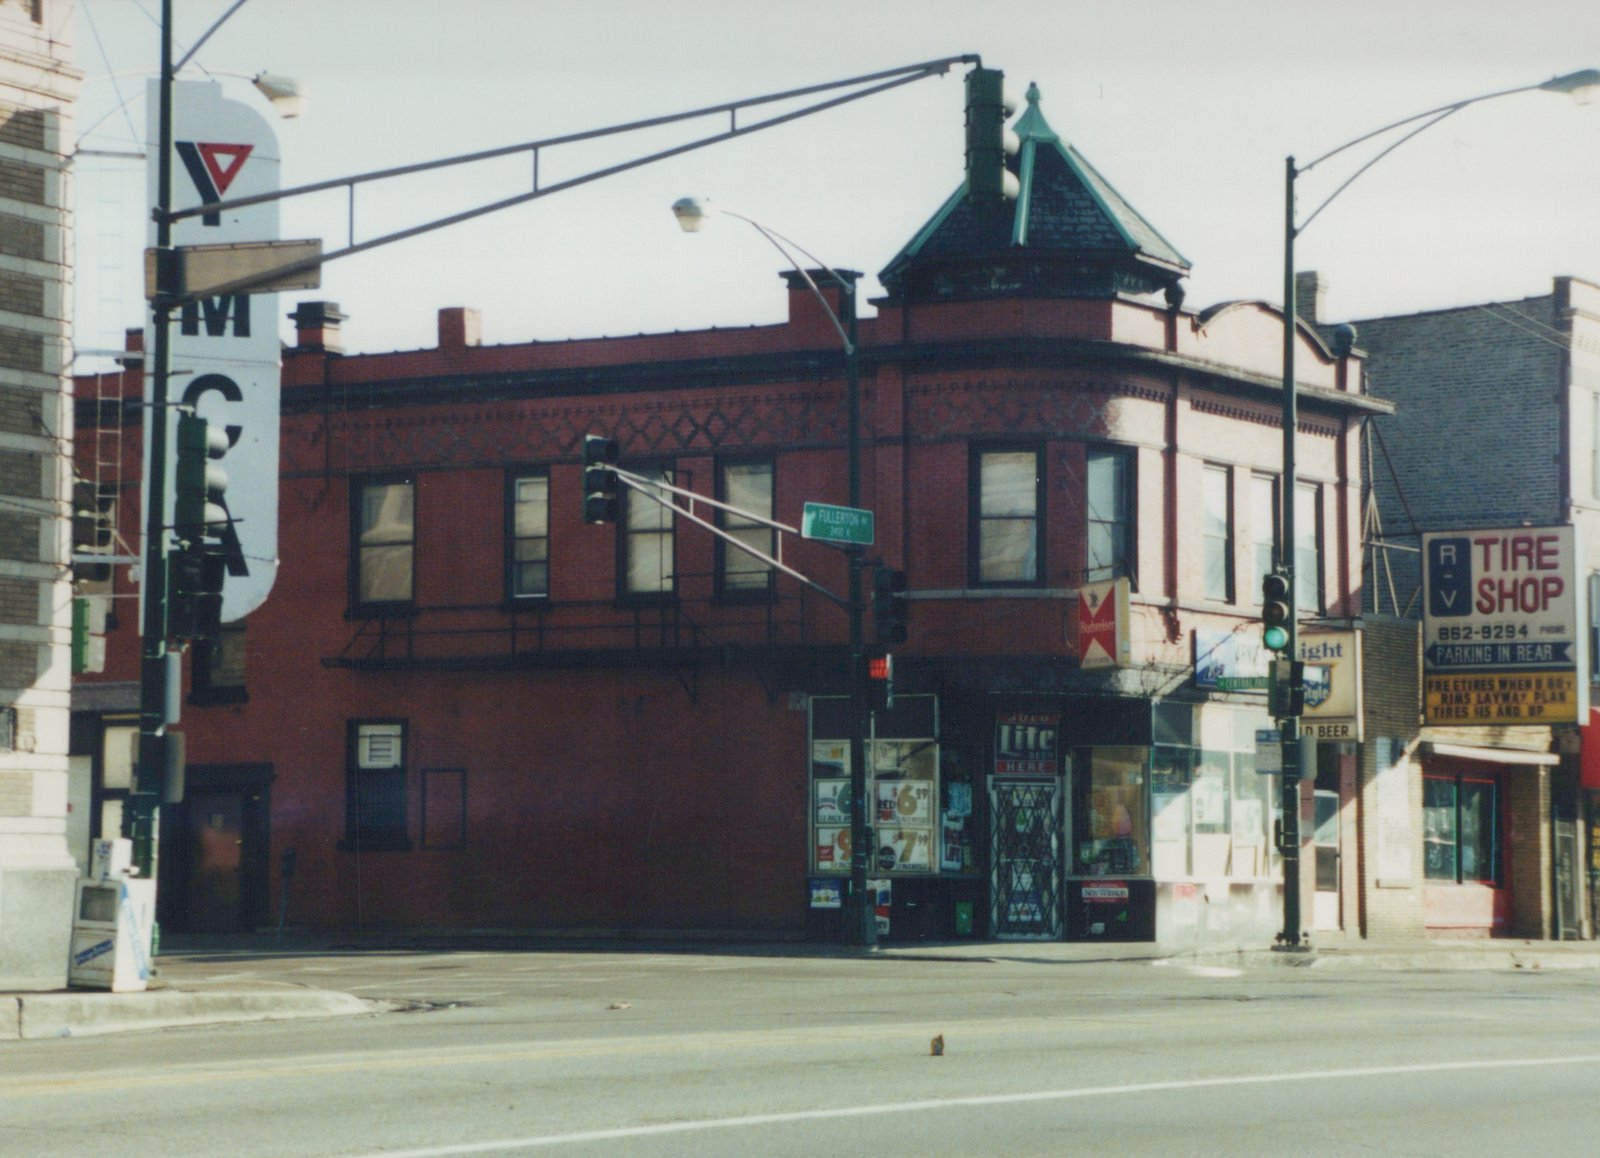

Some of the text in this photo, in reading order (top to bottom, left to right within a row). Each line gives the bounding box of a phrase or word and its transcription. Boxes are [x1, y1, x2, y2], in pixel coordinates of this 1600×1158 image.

[819, 509, 859, 526] FULLERTON
[1474, 535, 1560, 572] TIRE
[1475, 576, 1565, 615] SHOP
[1300, 641, 1344, 661] ight
[1436, 644, 1554, 663] PARKING IN REAR
[1225, 679, 1253, 689] CENTRAL
[1498, 679, 1533, 692] WHEN
[1440, 693, 1472, 705] RIMS
[1432, 705, 1469, 718] TIRES
[1497, 704, 1521, 717] AND
[1527, 703, 1544, 717] UP
[1318, 725, 1349, 738] BEER
[1007, 762, 1046, 772] HERE
